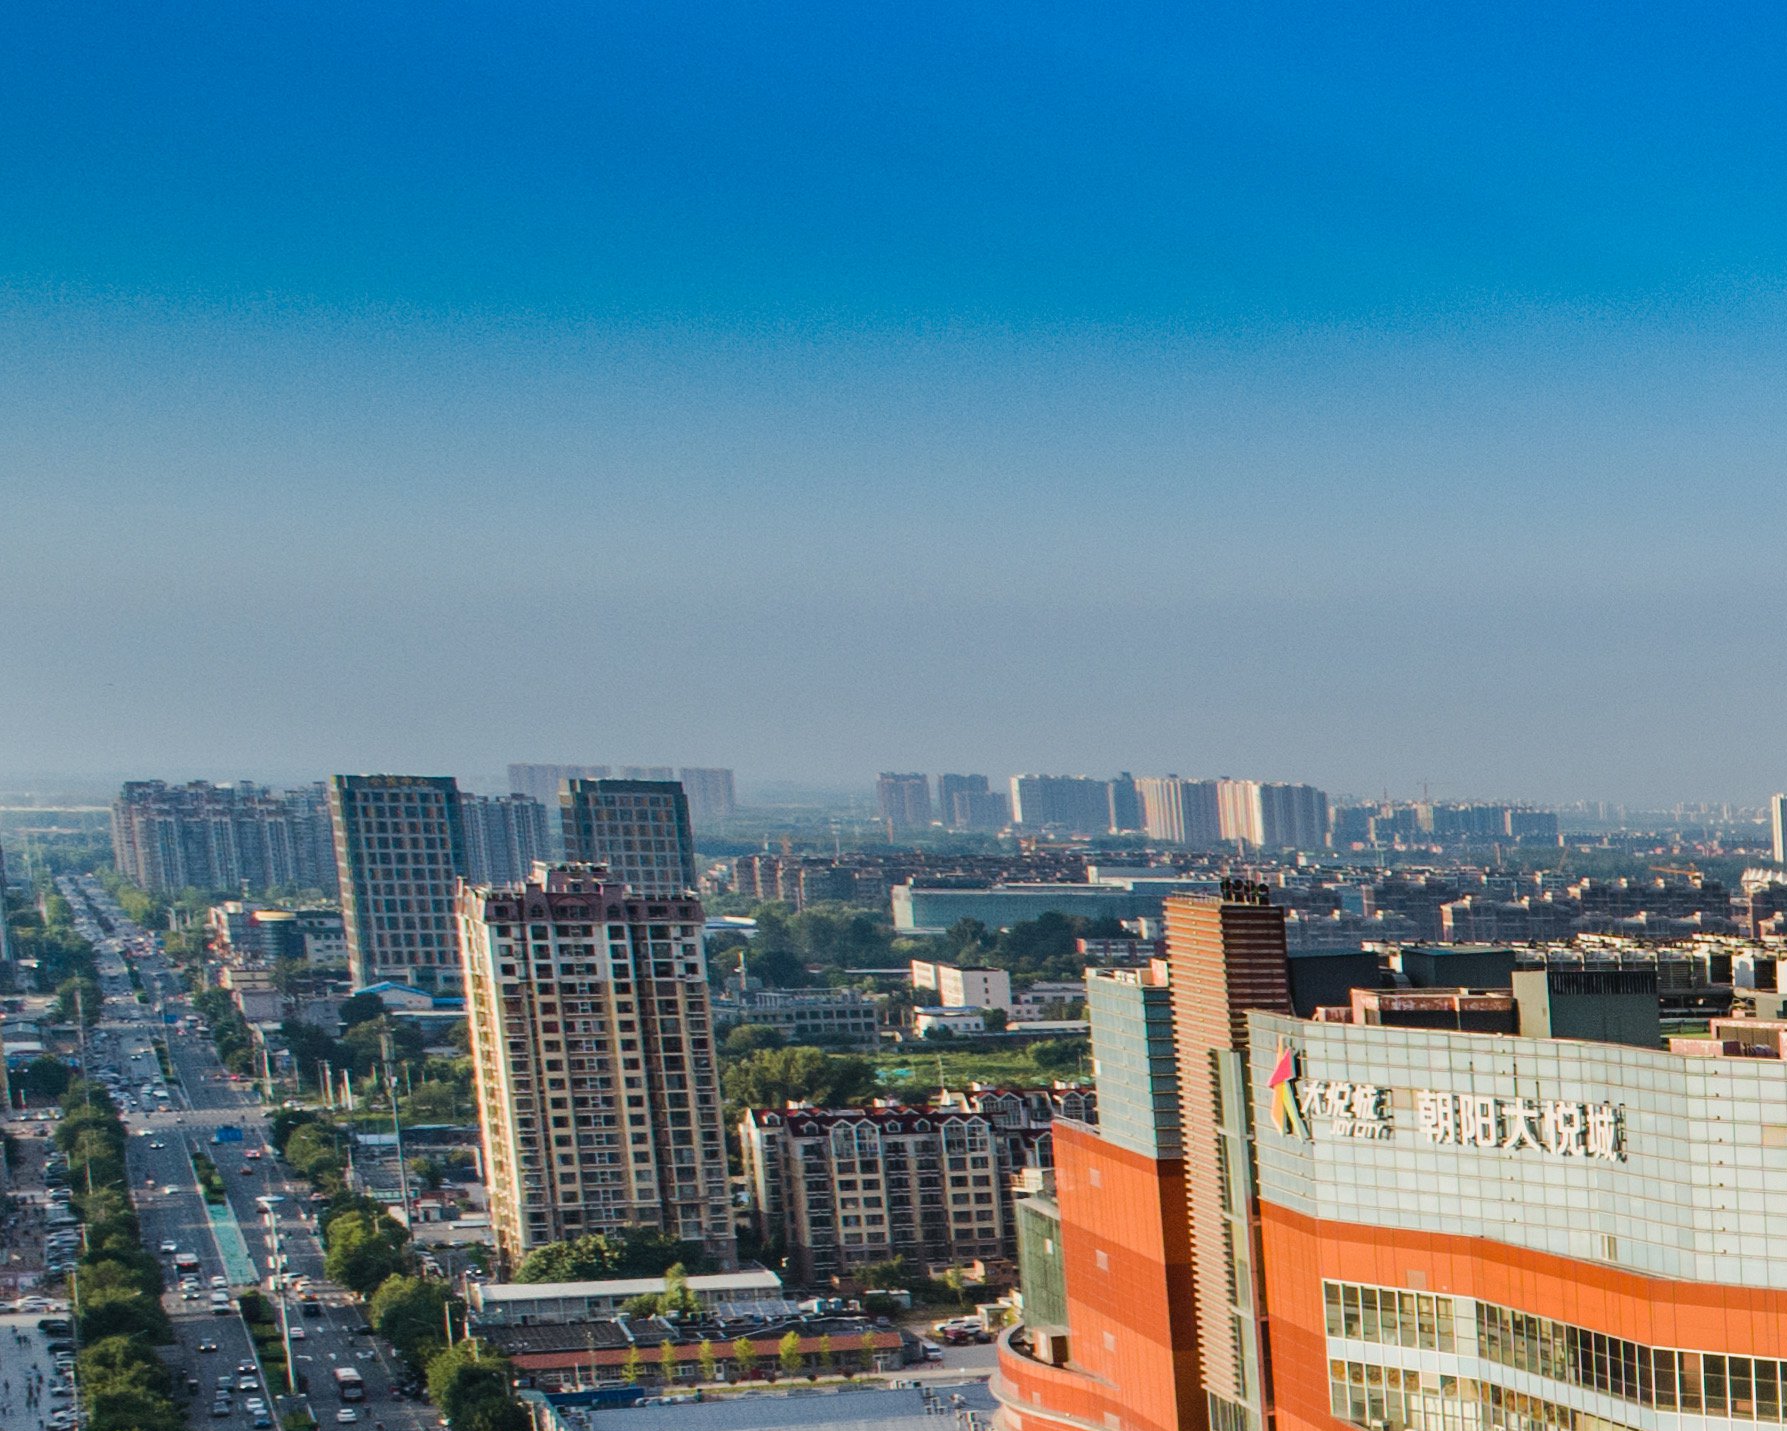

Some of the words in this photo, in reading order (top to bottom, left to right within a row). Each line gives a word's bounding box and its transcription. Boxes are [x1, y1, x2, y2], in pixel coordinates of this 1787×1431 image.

[1301, 1079, 1381, 1120] 大悦城
[1330, 1119, 1354, 1136] JOY
[1417, 1089, 1621, 1162] 朝阳大悦城
